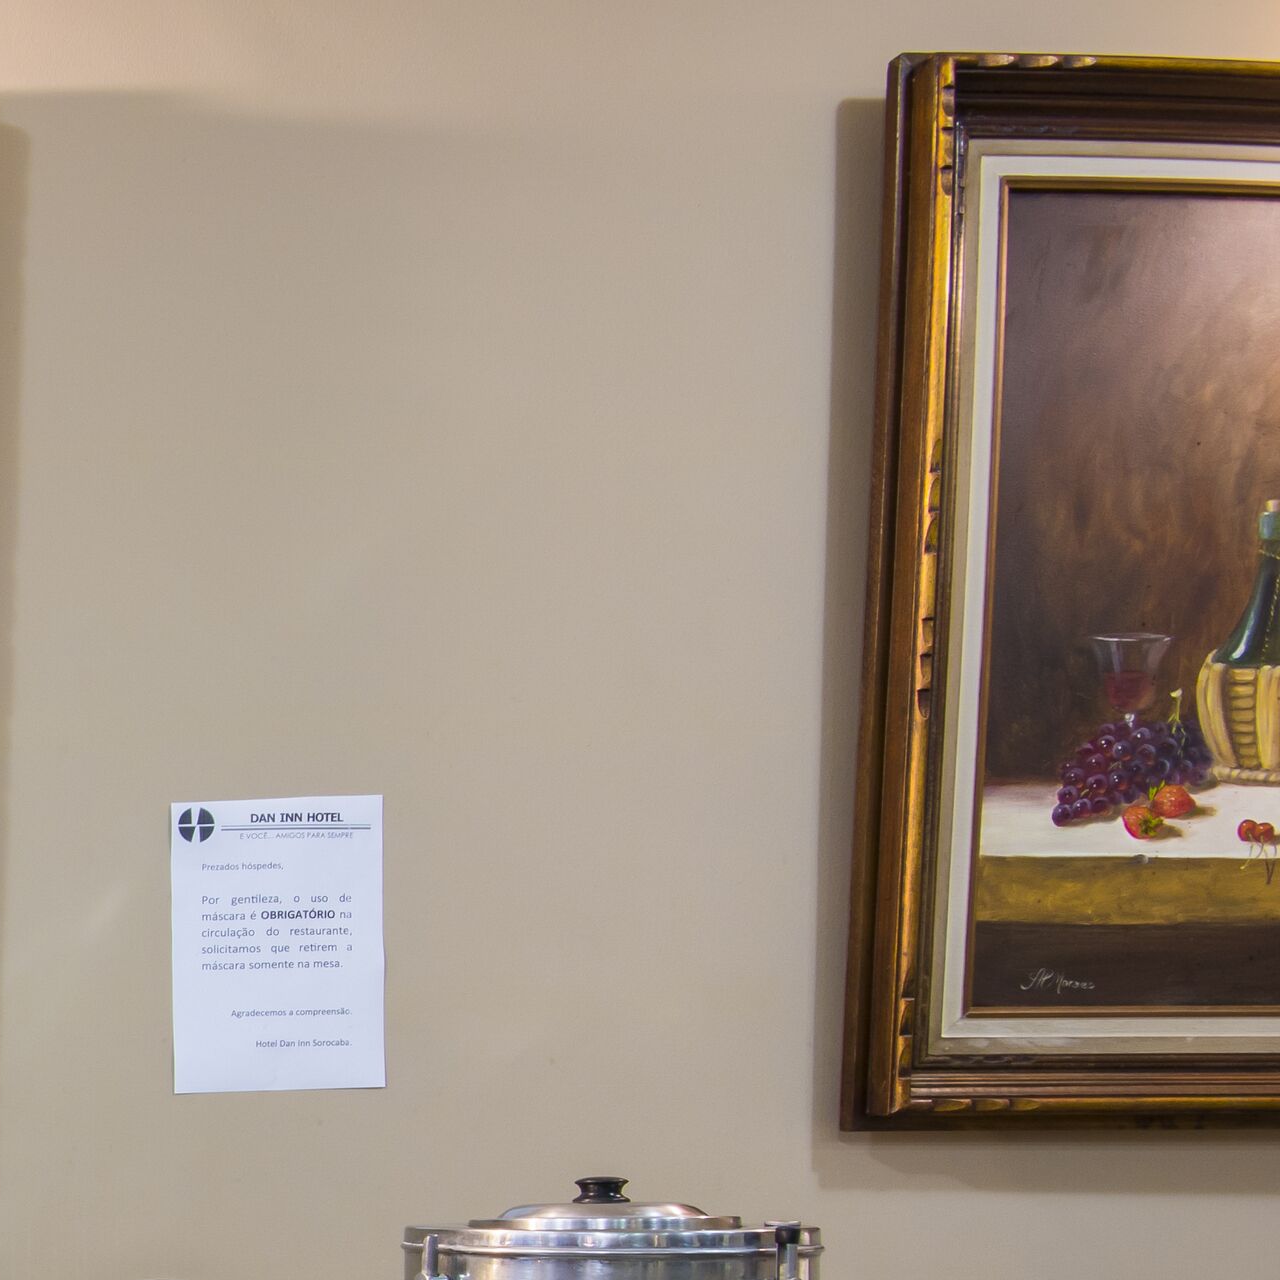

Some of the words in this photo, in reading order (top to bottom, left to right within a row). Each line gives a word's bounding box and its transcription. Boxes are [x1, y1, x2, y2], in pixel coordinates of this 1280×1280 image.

[250, 813, 275, 823] DAN
[280, 812, 303, 823] INN
[307, 812, 343, 823] HOTEL
[202, 862, 239, 871] Prezados
[242, 861, 284, 871] hóspedes,
[202, 896, 220, 904] Por
[231, 894, 282, 906] gentileza,
[339, 893, 351, 902] de
[202, 912, 245, 921] máscara
[250, 910, 256, 920] é
[261, 908, 335, 919] OBRIGATÓRIO
[202, 928, 255, 939] circulação
[266, 927, 279, 936] do
[290, 927, 352, 936] restaurante,
[202, 944, 263, 954] solicitamos
[271, 945, 290, 954] que
[299, 943, 337, 952] retirem
[202, 961, 245, 970] máscara
[249, 961, 294, 969] somente
[231, 1008, 286, 1018] Agradecemos
[295, 1008, 352, 1017] compreensão.
[256, 1040, 277, 1048] Hotel
[279, 1039, 296, 1047] Dan
[298, 1039, 310, 1047] Inn
[312, 1039, 352, 1047] Sorocaba.
